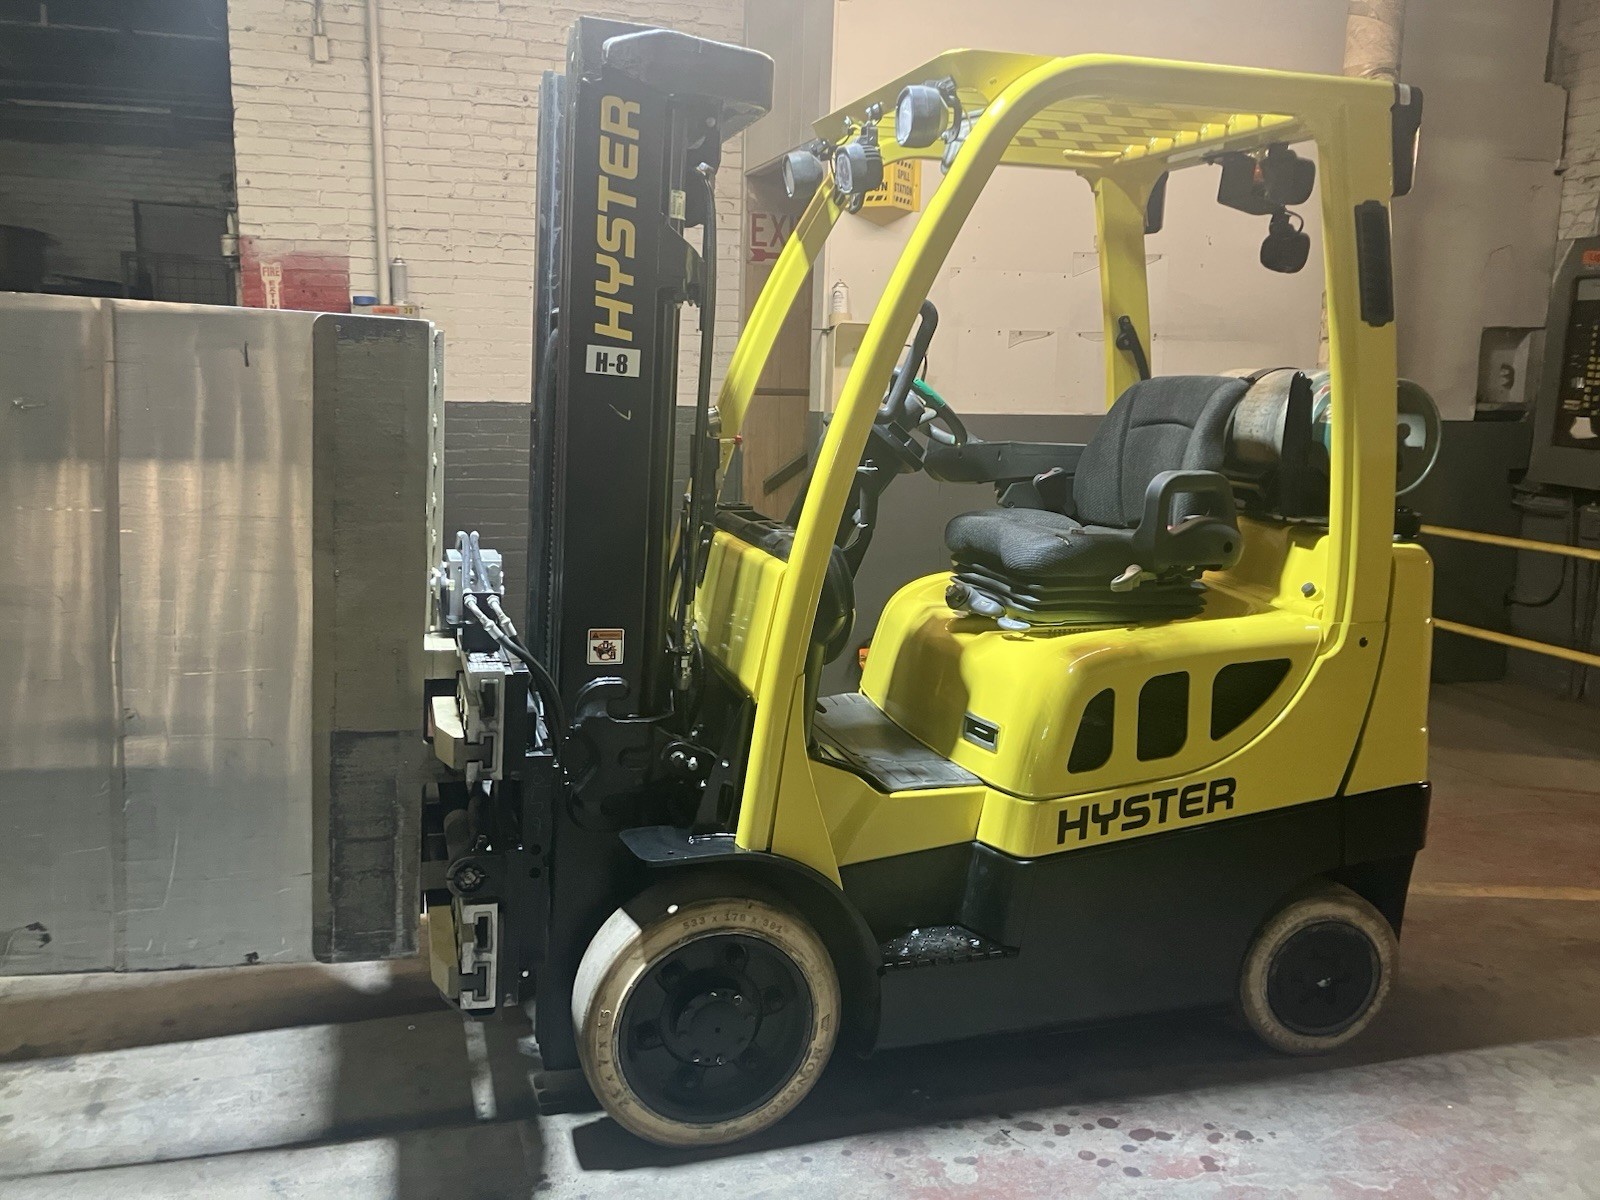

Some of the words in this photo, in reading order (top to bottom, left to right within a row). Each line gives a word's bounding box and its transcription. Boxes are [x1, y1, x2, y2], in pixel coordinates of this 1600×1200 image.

[897, 169, 910, 181] SPILL
[594, 94, 640, 341] HYSTER
[751, 213, 798, 247] EXI
[262, 266, 280, 276] FIRE
[596, 352, 628, 374] H-8
[1057, 777, 1237, 845] HYSTER
[682, 915, 706, 930] 533
